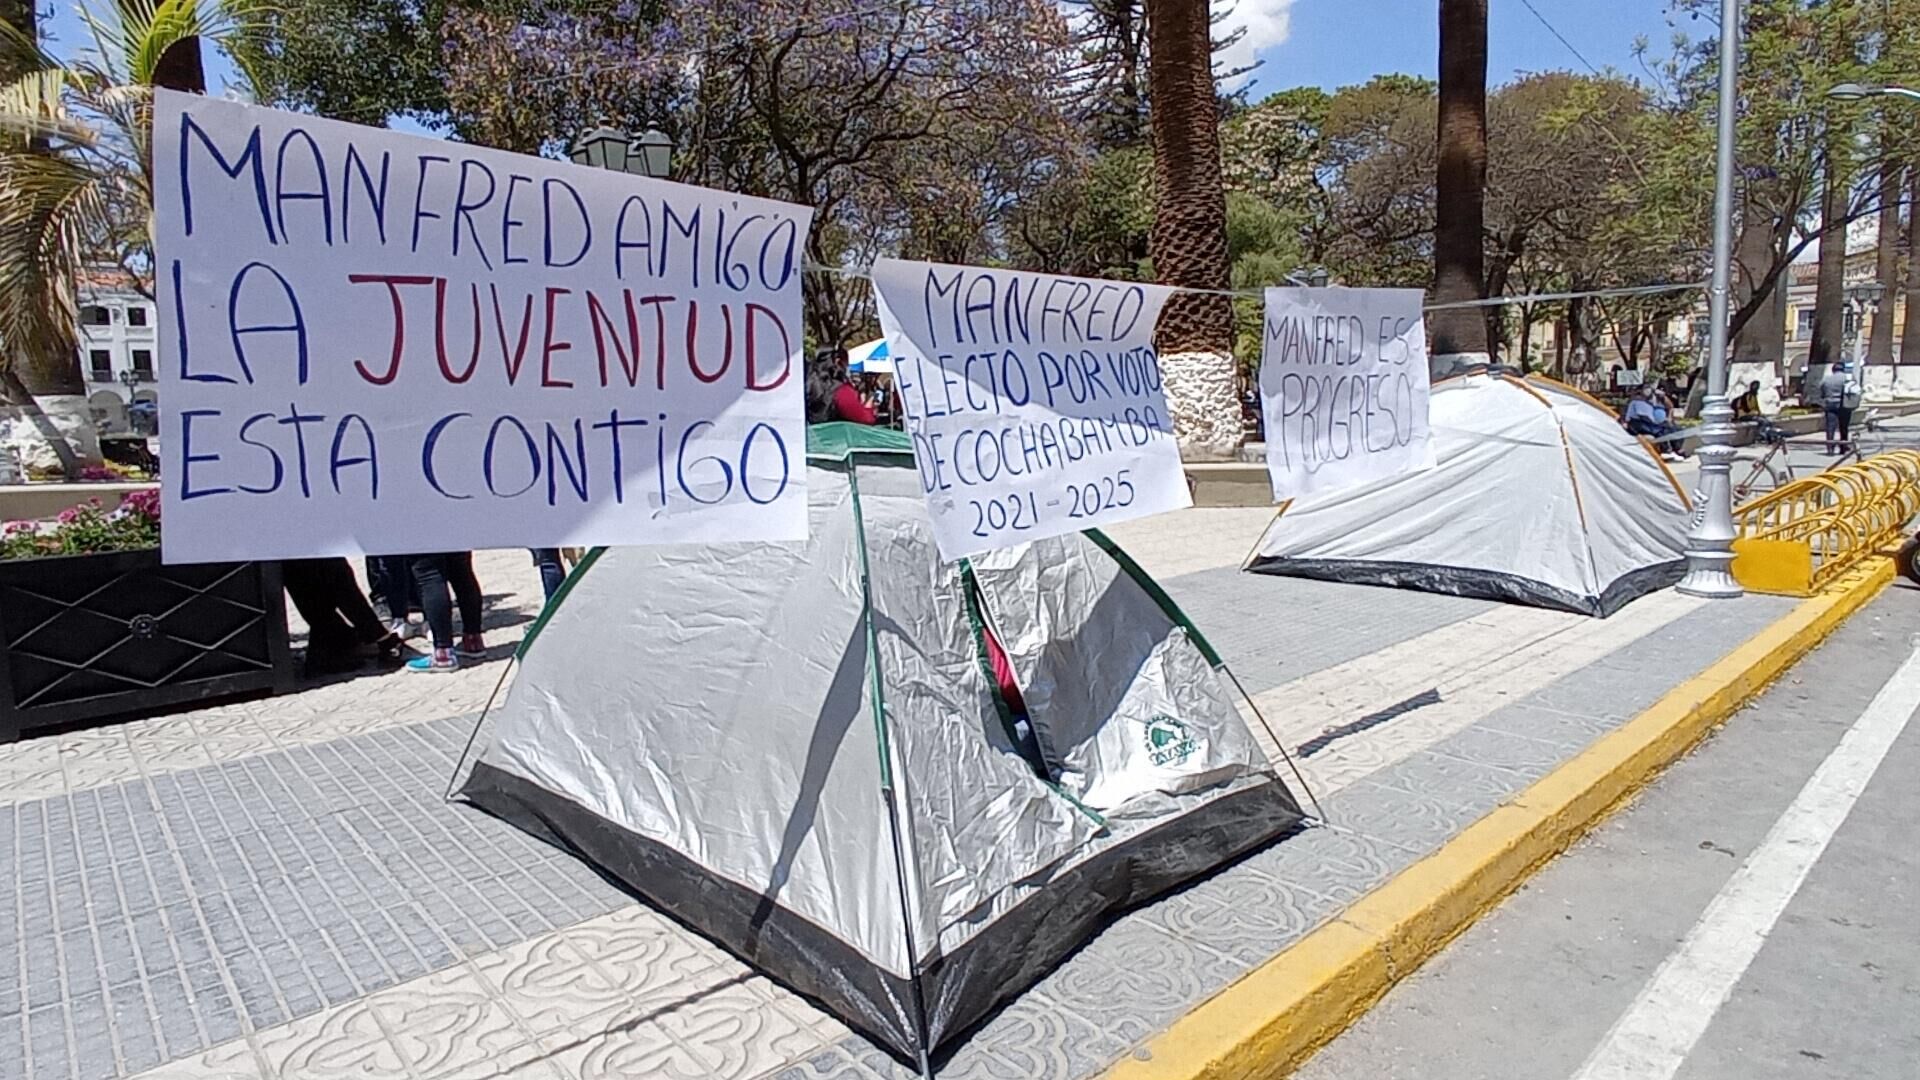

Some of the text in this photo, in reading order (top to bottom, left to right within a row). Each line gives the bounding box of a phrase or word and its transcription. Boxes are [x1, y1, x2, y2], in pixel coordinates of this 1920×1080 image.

[181, 112, 796, 291] MANFRED AMIGO
[173, 259, 791, 391] LA JUVENTUD
[925, 268, 1144, 348] MANFRED
[1265, 315, 1409, 367] MANFRED ES
[894, 346, 1160, 420] ELECTO POR VOTO
[1282, 373, 1412, 473] PROGRESO
[912, 405, 1163, 493] DE COCHABAMBA
